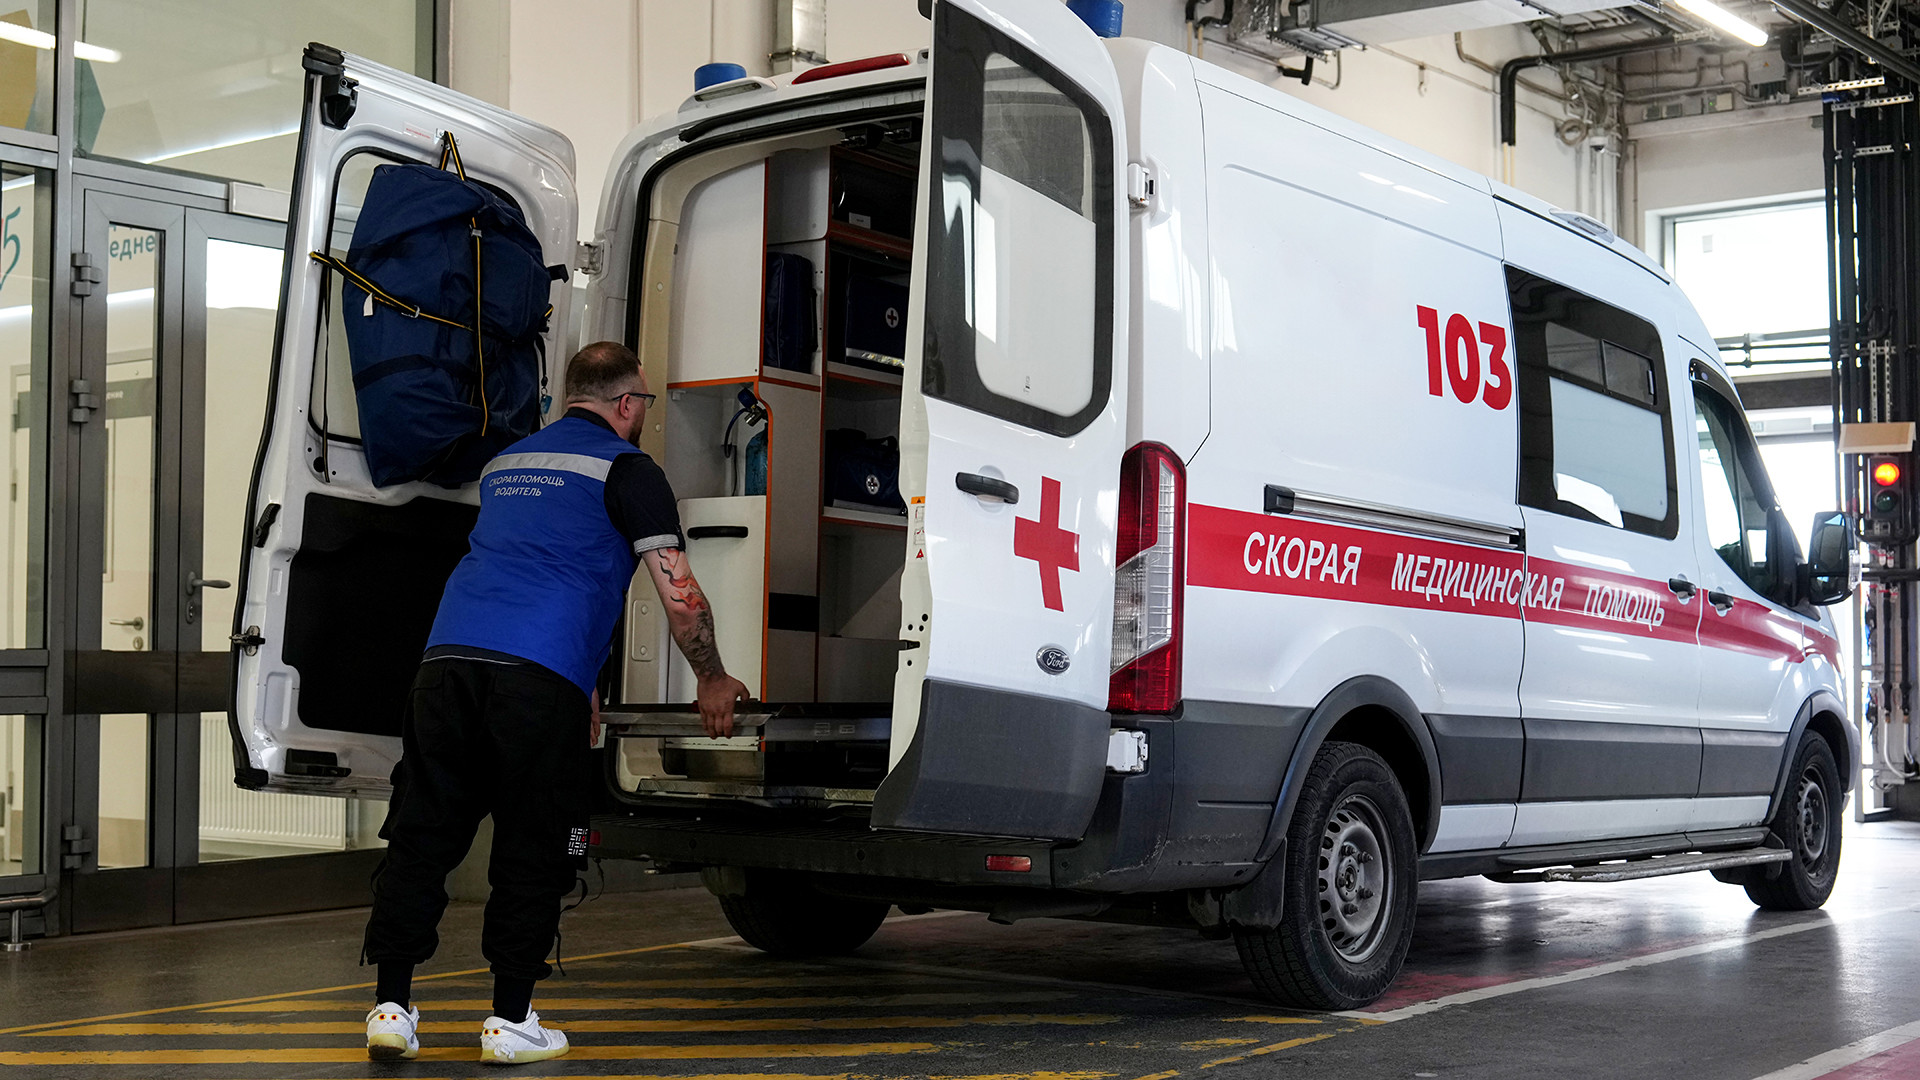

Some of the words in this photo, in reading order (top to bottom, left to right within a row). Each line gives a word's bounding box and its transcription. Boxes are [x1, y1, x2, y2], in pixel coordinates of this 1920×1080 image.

[1416, 304, 1512, 411] 103
[489, 475, 518, 487] СКОРАЯ
[519, 475, 565, 487] ПОМОЩЬ
[494, 487, 542, 497] ВОДИТЕЛЬ
[1243, 531, 1362, 586] СКОРАЯ
[1391, 553, 1565, 611] МЕДИЦИНСКАЯ
[1583, 583, 1666, 632] ПОМОЩЬ
